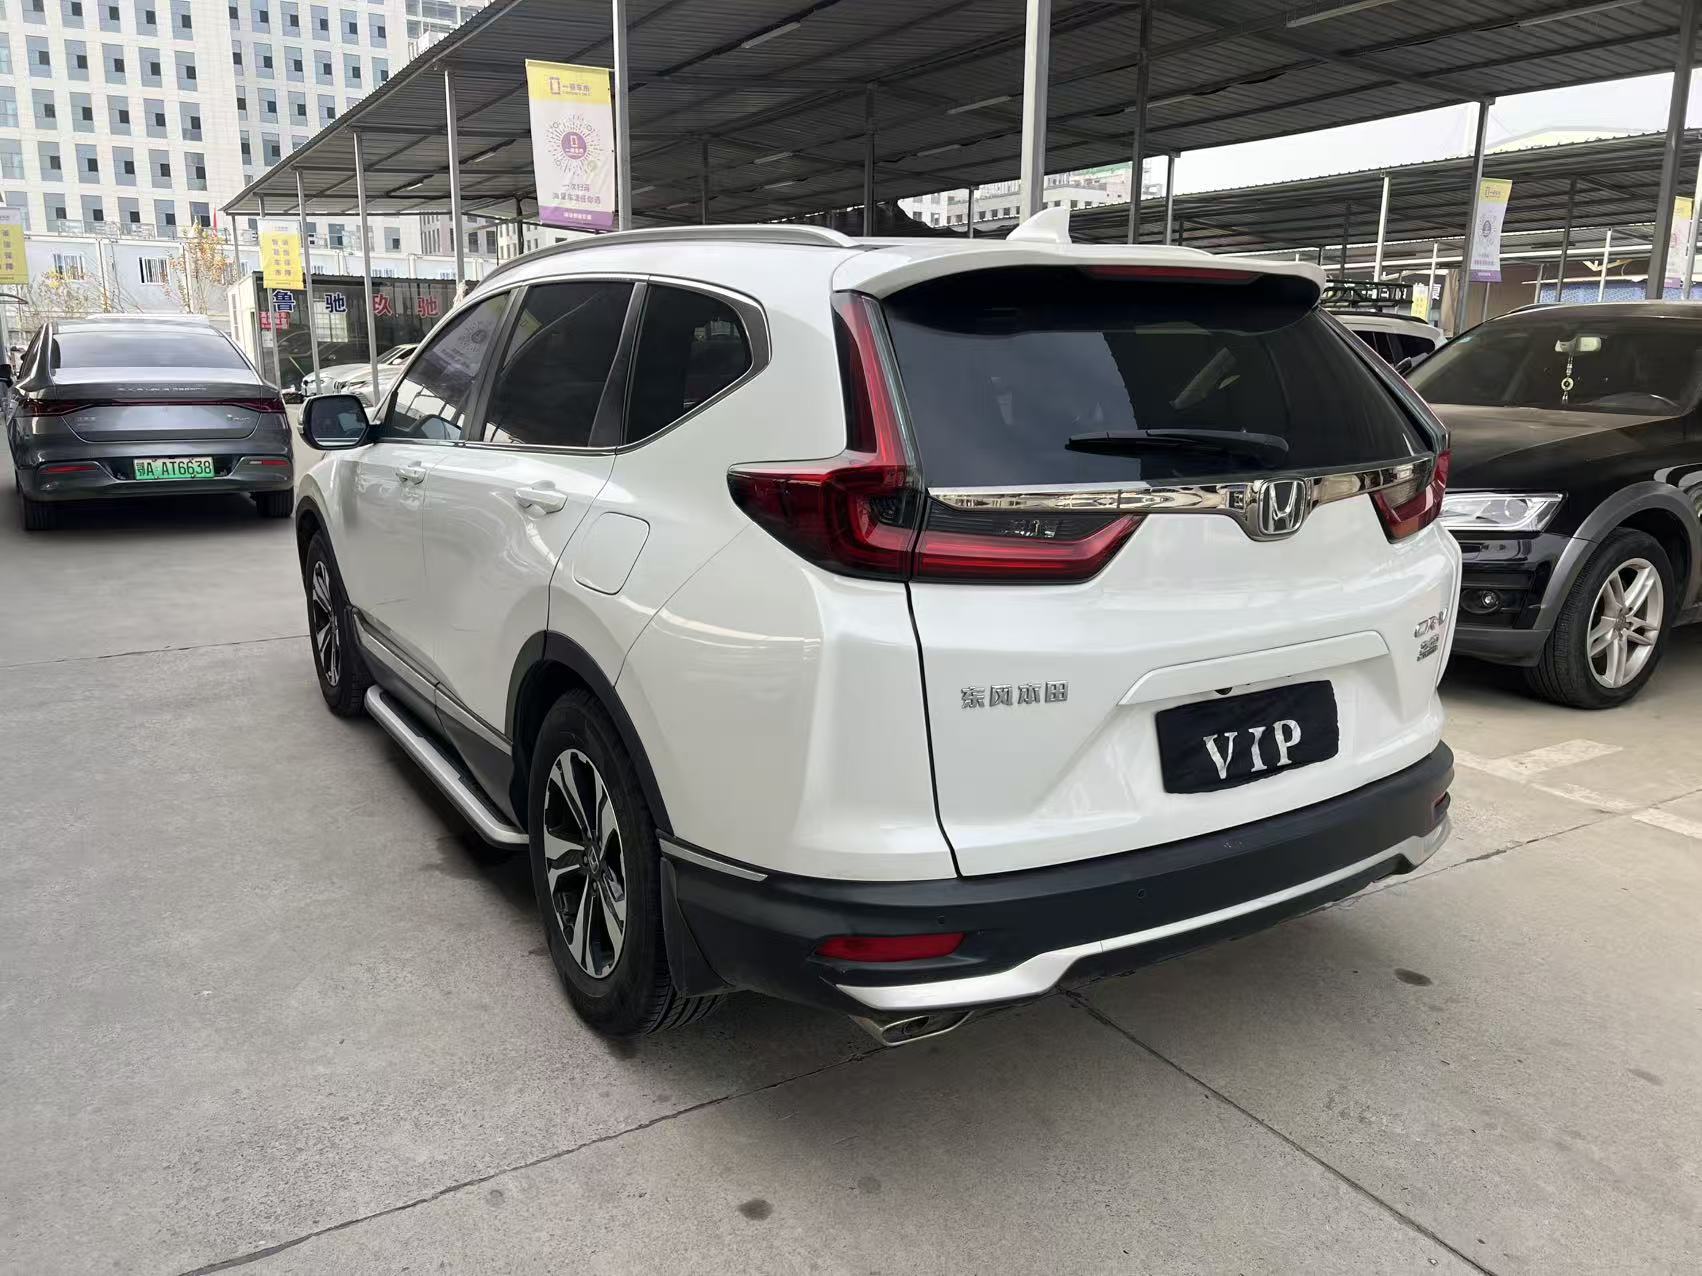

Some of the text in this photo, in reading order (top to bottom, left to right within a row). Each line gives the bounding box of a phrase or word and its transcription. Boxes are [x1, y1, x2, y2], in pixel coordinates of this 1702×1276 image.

[961, 680, 1068, 709] 东风本田
[1203, 719, 1302, 780] VIP
